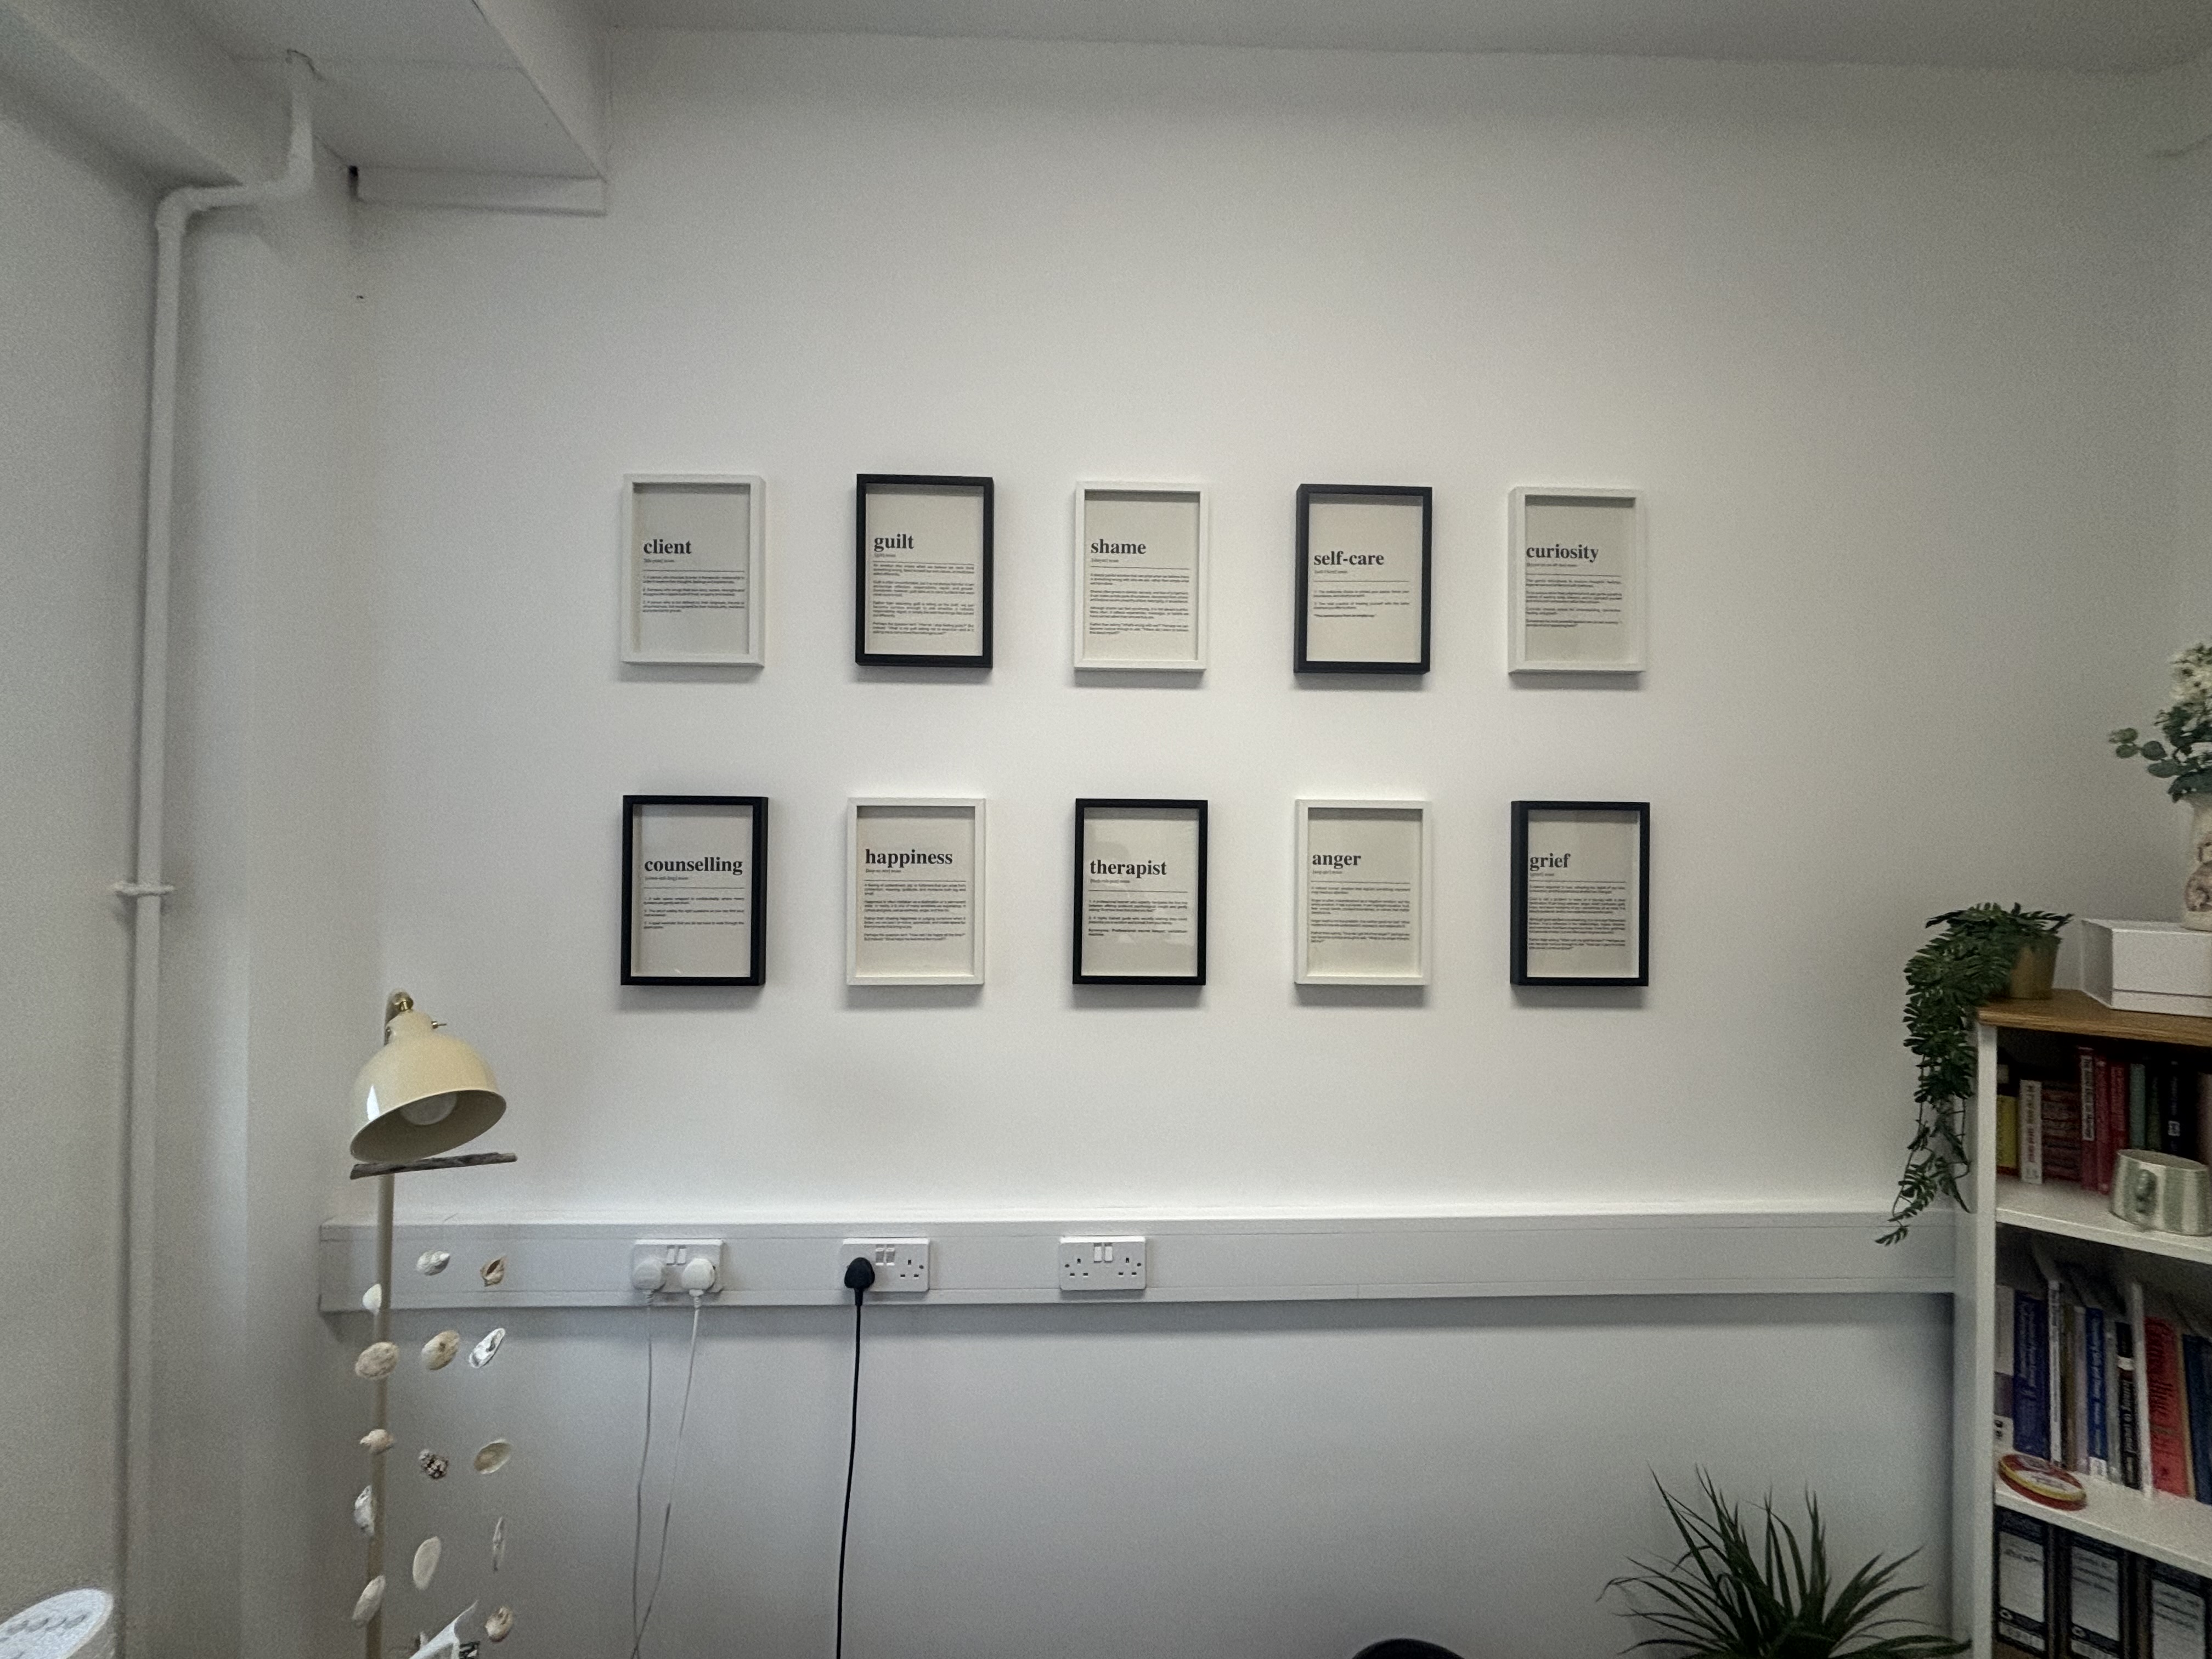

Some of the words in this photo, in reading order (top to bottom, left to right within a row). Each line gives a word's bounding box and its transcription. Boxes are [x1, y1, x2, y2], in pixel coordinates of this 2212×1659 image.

[643, 539, 692, 555] client
[873, 533, 914, 552] guilt
[1091, 538, 1147, 555] shame
[1313, 550, 1384, 566] self-care
[1526, 543, 1599, 563] curiosity
[644, 856, 743, 876] counselling
[865, 848, 953, 868] happiness
[1312, 854, 1362, 870] anger
[1530, 853, 1571, 872] grief
[1090, 859, 1167, 878] therapist
